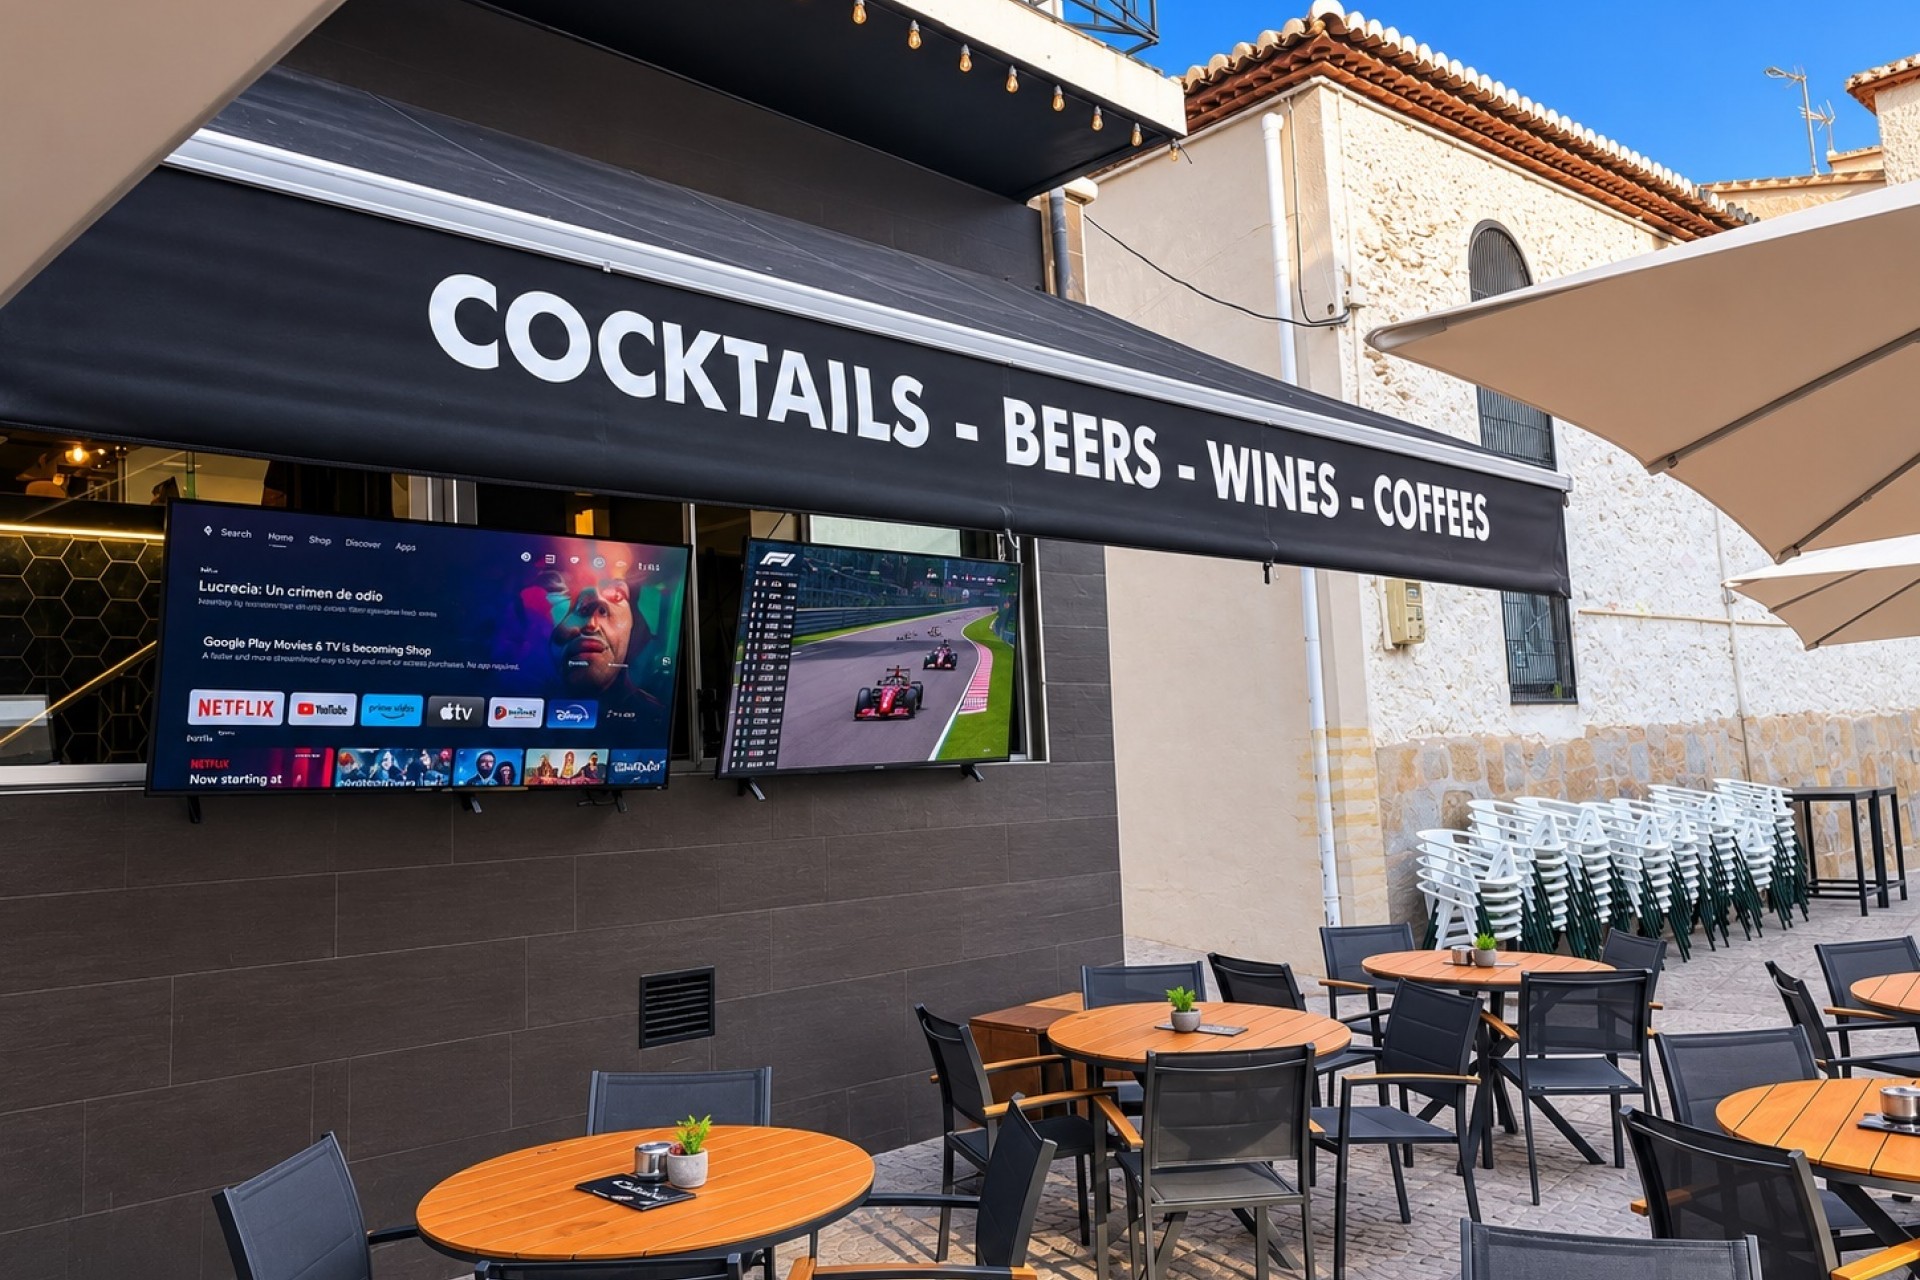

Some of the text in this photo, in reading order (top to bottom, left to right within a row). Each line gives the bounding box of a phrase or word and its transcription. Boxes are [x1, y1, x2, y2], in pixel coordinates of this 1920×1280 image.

[428, 273, 930, 449] COCKTAILS
[1003, 396, 1161, 490] BEERS
[1206, 440, 1340, 519] WINES
[1374, 474, 1490, 542] COFFEES
[220, 527, 416, 553] Search Home Shop Discover Apps
[759, 551, 797, 568] F1
[199, 579, 383, 602] Lucrecia: Un crimen de odio
[203, 635, 246, 650] Google
[247, 637, 272, 652] Play
[273, 639, 314, 652] Movies
[325, 642, 341, 652] TV
[341, 642, 351, 653] is
[352, 643, 404, 657] becoming
[405, 644, 432, 658] Shop
[202, 651, 210, 660] A
[198, 698, 275, 718] NETFLIX
[315, 703, 348, 715] YouTube
[368, 703, 392, 714] prime
[455, 703, 473, 721] tv
[190, 759, 230, 770] NETFLIX
[190, 773, 282, 787] Now starting at
